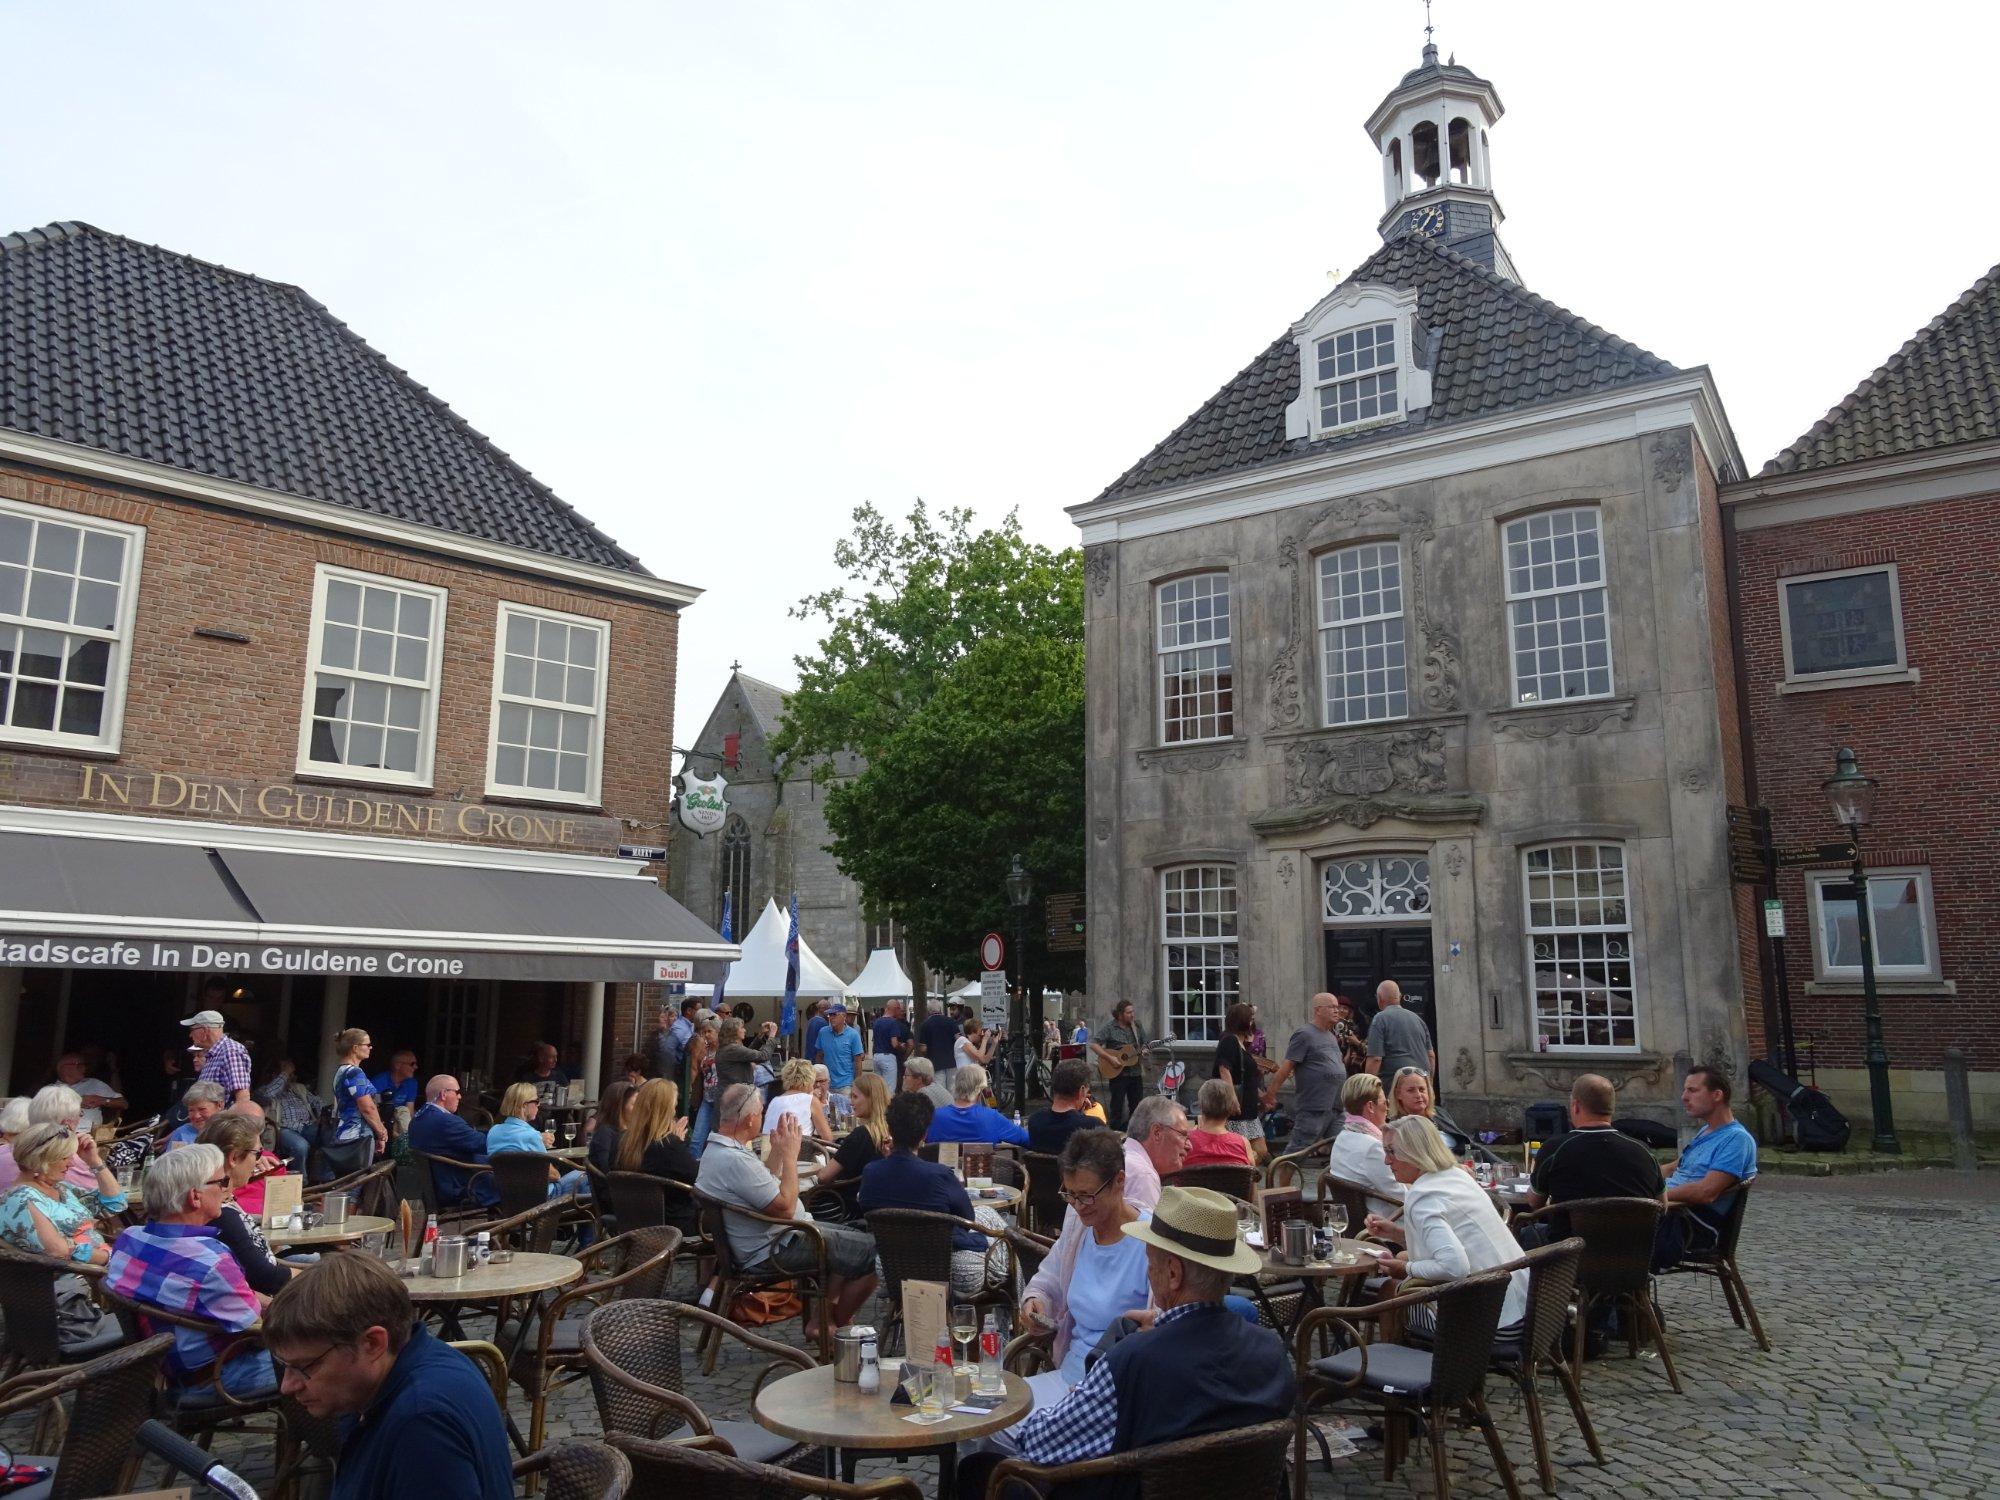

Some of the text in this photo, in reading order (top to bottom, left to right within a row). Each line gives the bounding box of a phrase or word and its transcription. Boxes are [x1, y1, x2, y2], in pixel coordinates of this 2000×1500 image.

[78, 765, 576, 844] IN DEN GULDENE CRONE
[631, 847, 653, 858] MARKT
[152, 943, 181, 967] In
[191, 944, 251, 969] Den
[261, 947, 379, 972] Guldene
[386, 951, 464, 975] Crone
[659, 966, 688, 980] Duvel
